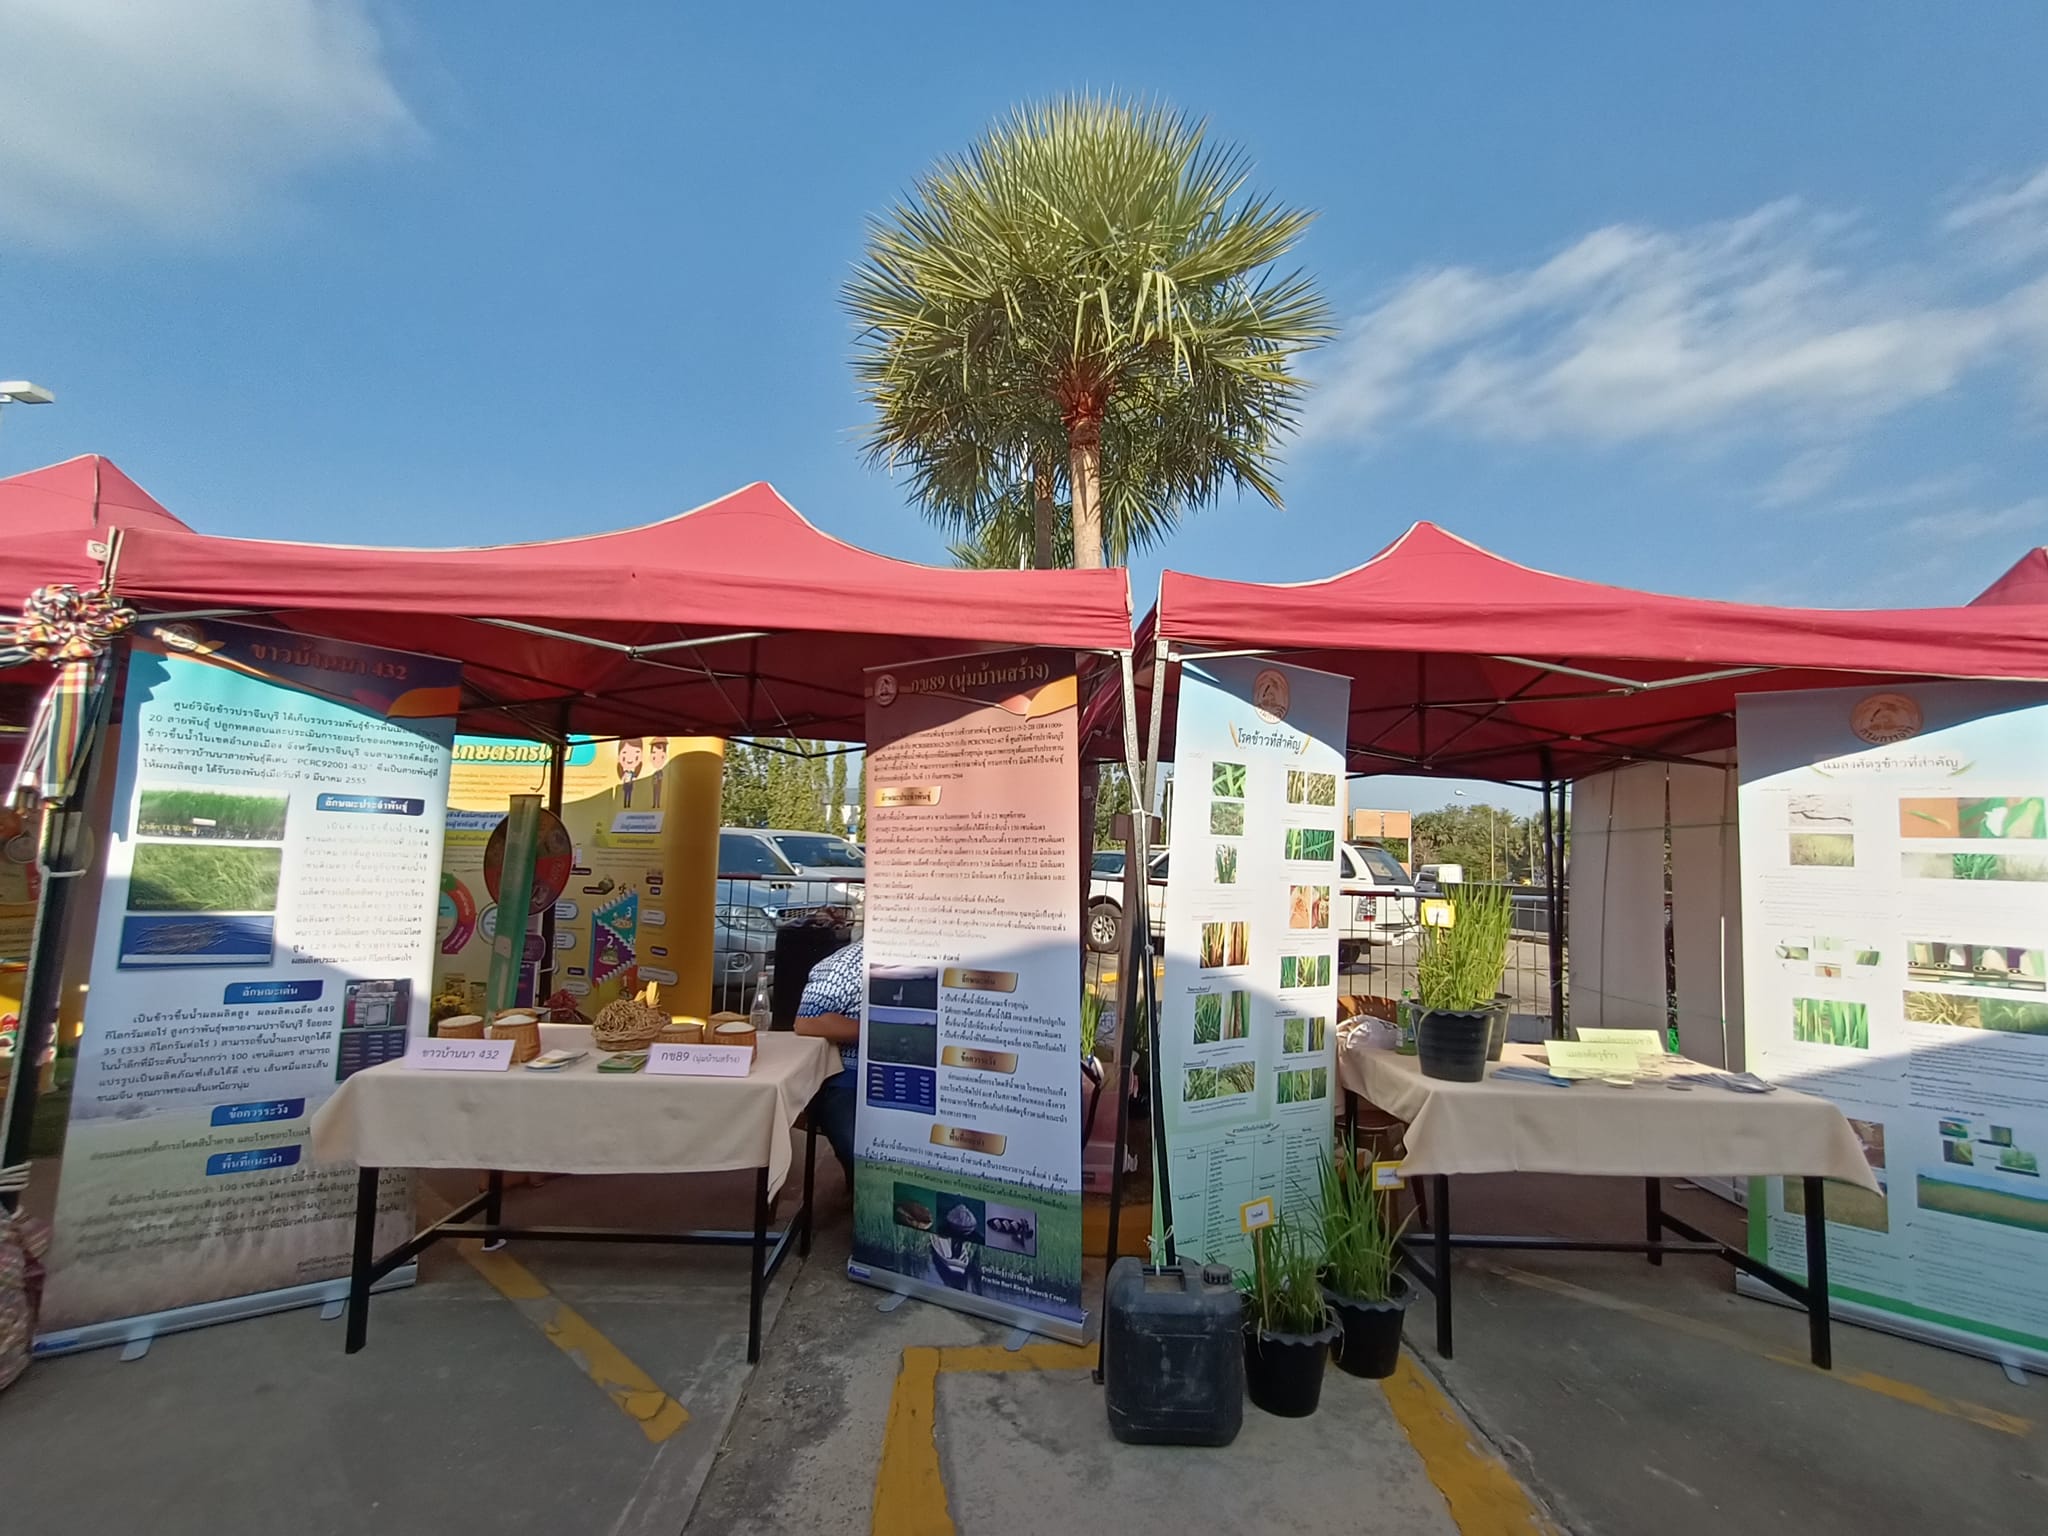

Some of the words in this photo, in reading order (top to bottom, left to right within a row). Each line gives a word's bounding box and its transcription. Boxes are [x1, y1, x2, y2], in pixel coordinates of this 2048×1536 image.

[250, 641, 368, 676] ขาวบ้านนา
[371, 662, 408, 681] 432
[911, 674, 946, 692] กข89
[949, 656, 1050, 696] (นุ่มบ้านสร้าง)
[1237, 728, 1302, 754] โรคข้าวที่สำคัญ
[242, 985, 298, 998] ลักษณะเด่น
[422, 1046, 476, 1060] ขาวบ้านนา
[479, 1049, 500, 1061] 432
[661, 1051, 690, 1063] กข89
